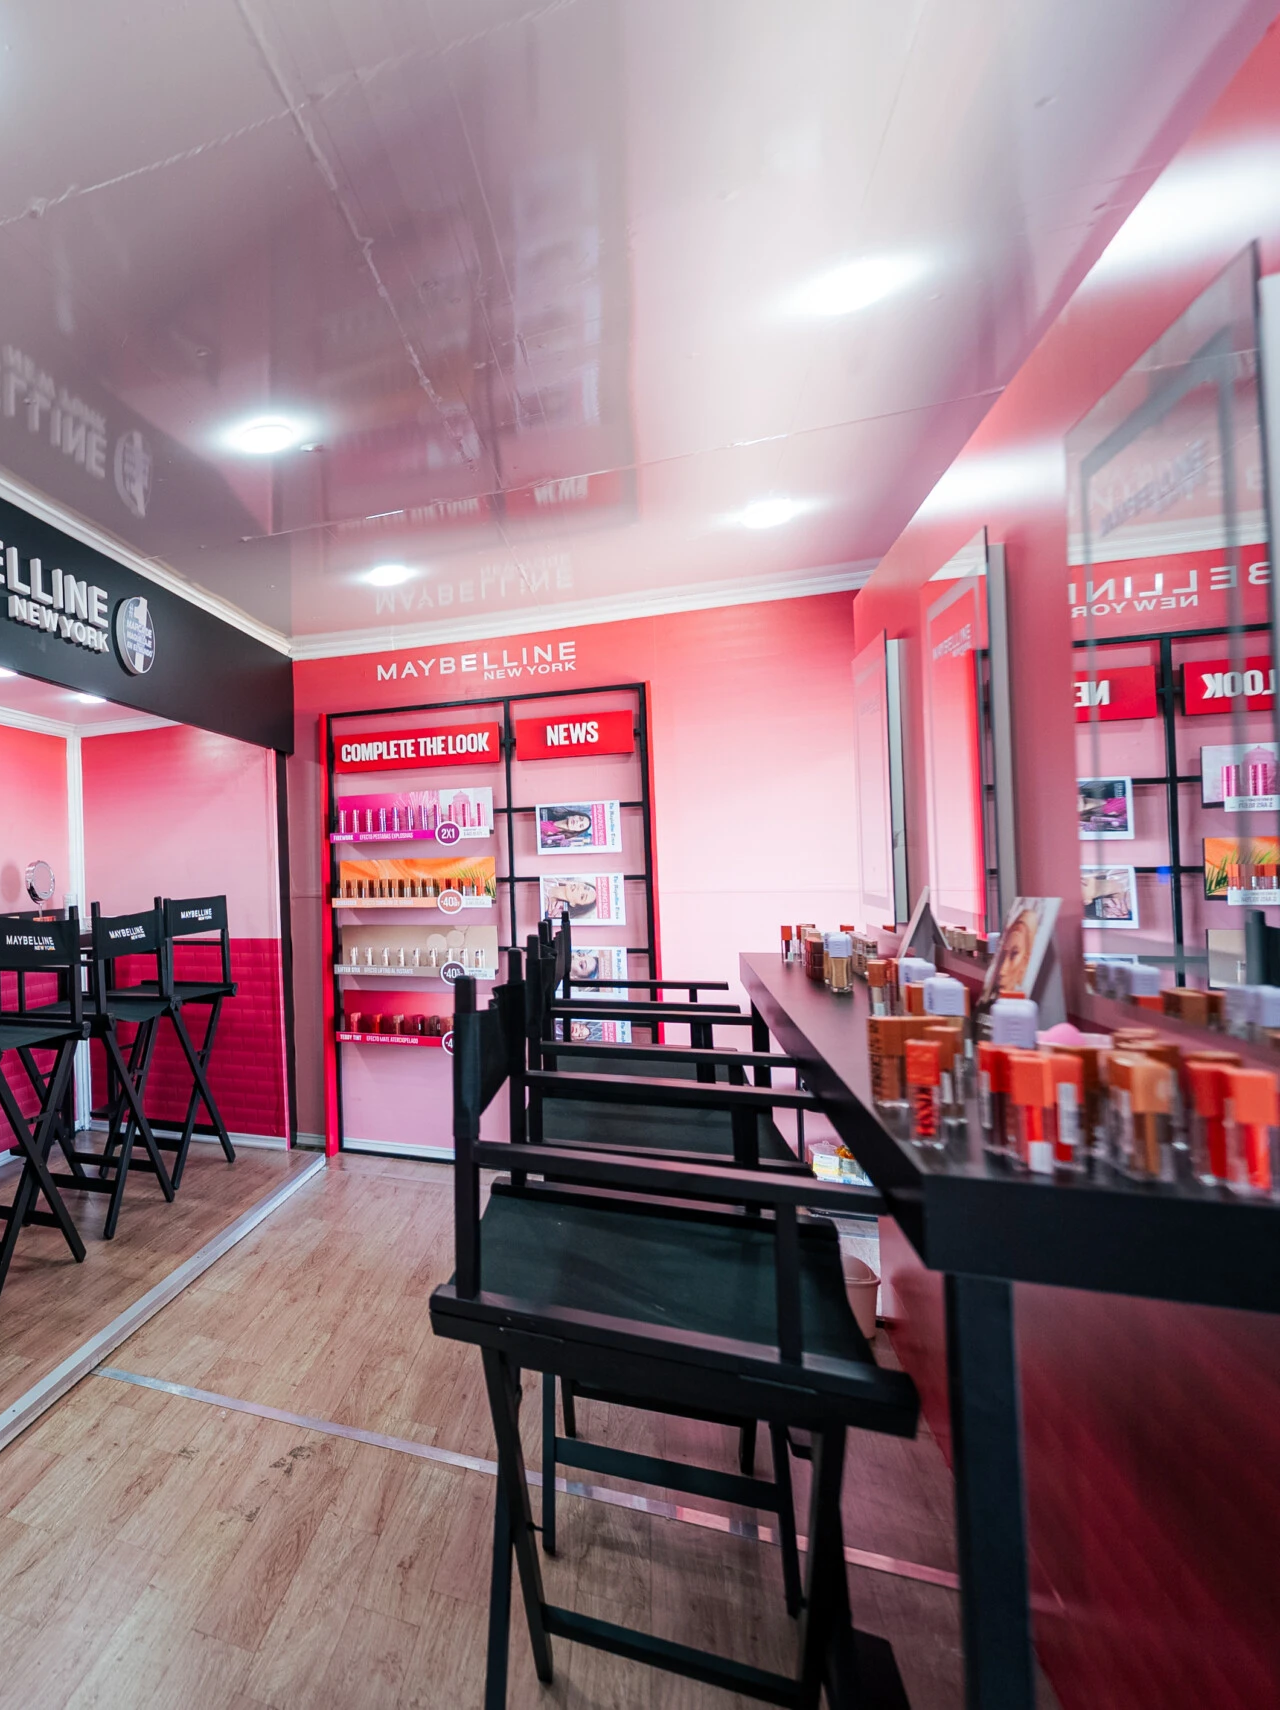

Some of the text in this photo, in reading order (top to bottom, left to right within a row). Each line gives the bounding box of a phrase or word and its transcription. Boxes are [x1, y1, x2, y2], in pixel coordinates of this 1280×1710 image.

[8, 595, 109, 652] NEW YORK
[377, 641, 576, 681] MAYBELLINE
[484, 661, 576, 681] NEW YORK
[545, 721, 599, 746] NEWS
[341, 732, 489, 763] COMPLETE THE LOOK
[441, 829, 455, 840] 2X1
[180, 908, 213, 919] MAYBELLINE
[6, 935, 54, 945] MAYBELLINE
[109, 925, 145, 939] MAYBELLINE
